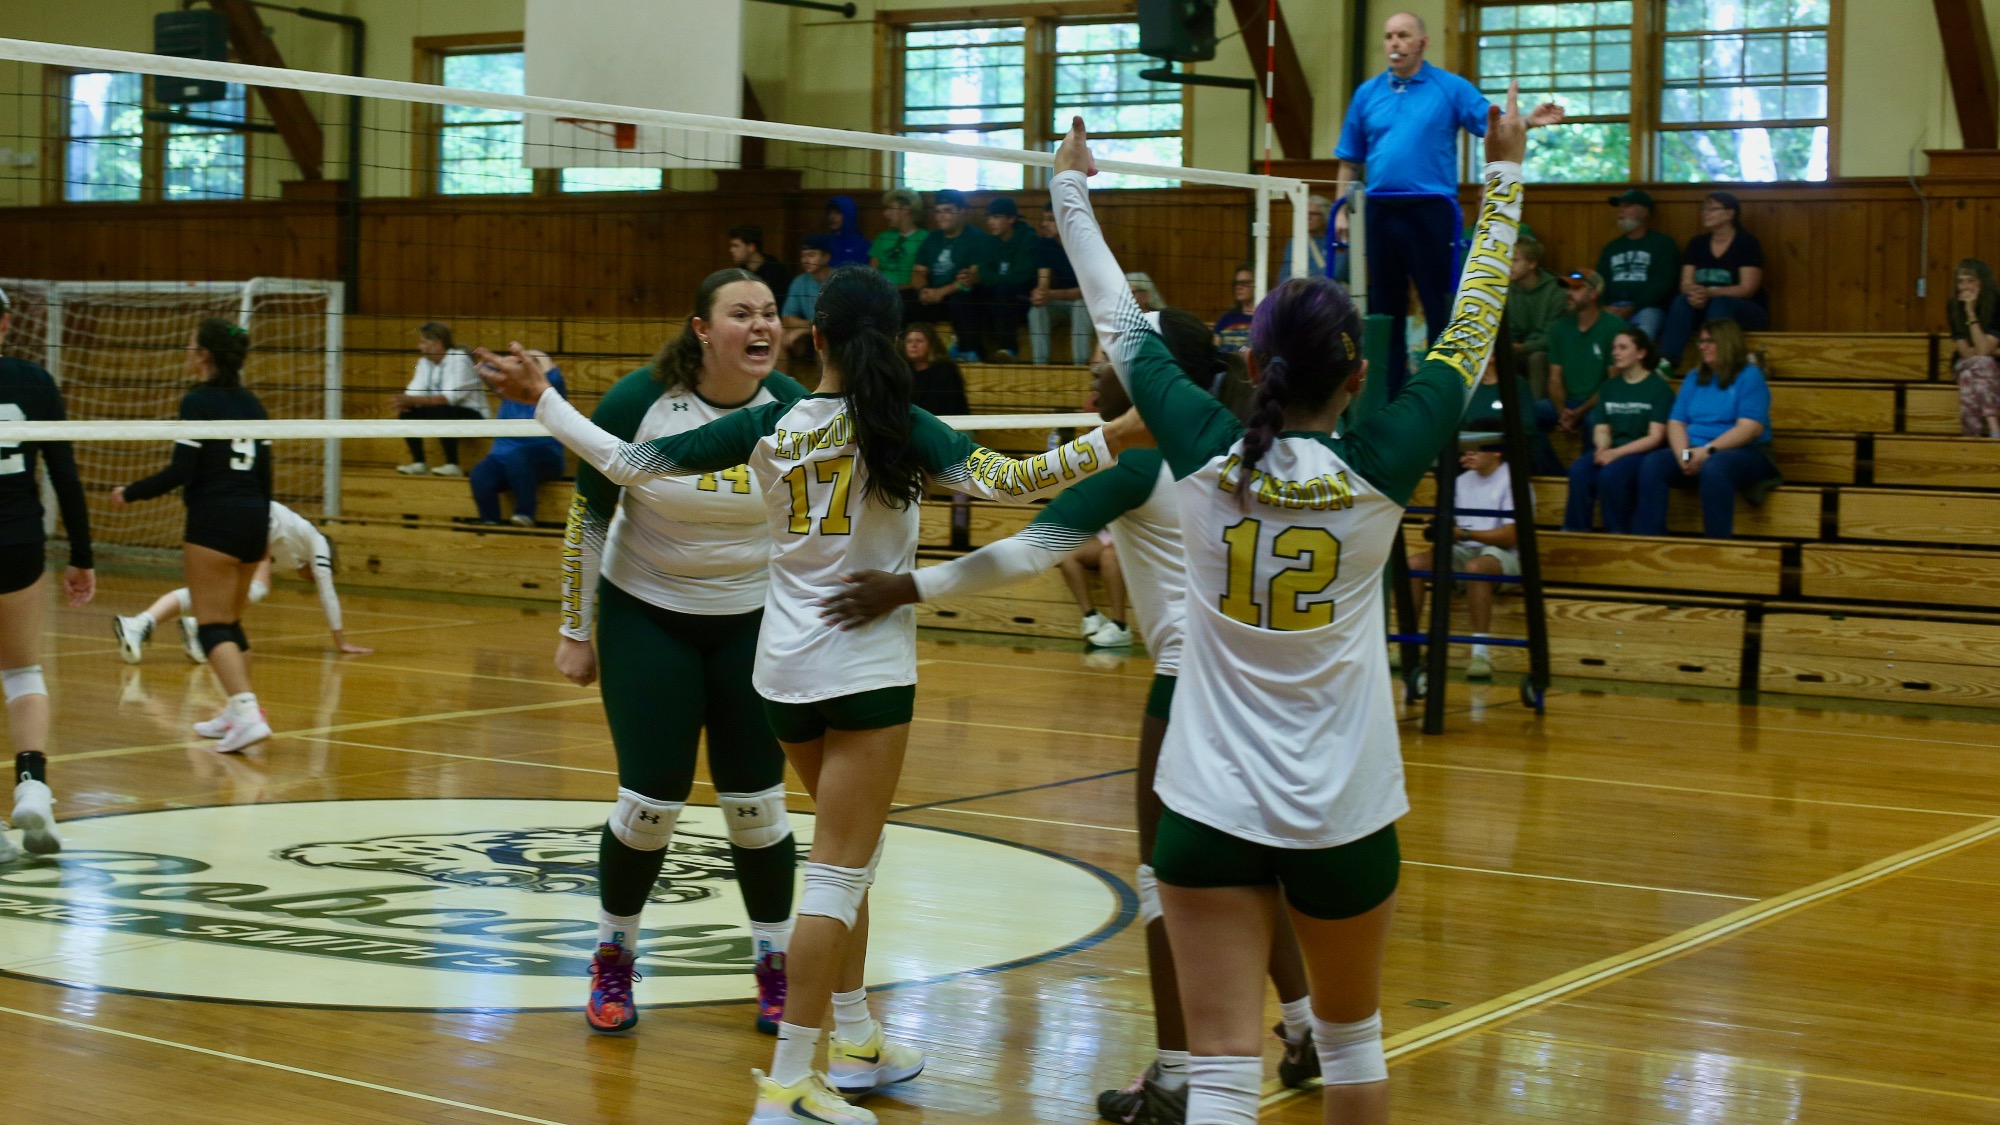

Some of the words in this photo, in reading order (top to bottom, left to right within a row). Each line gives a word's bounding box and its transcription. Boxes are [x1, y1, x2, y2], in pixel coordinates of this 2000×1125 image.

[775, 412, 857, 460] LYNDO
[782, 454, 855, 536] 17
[1220, 516, 1342, 632] 12
